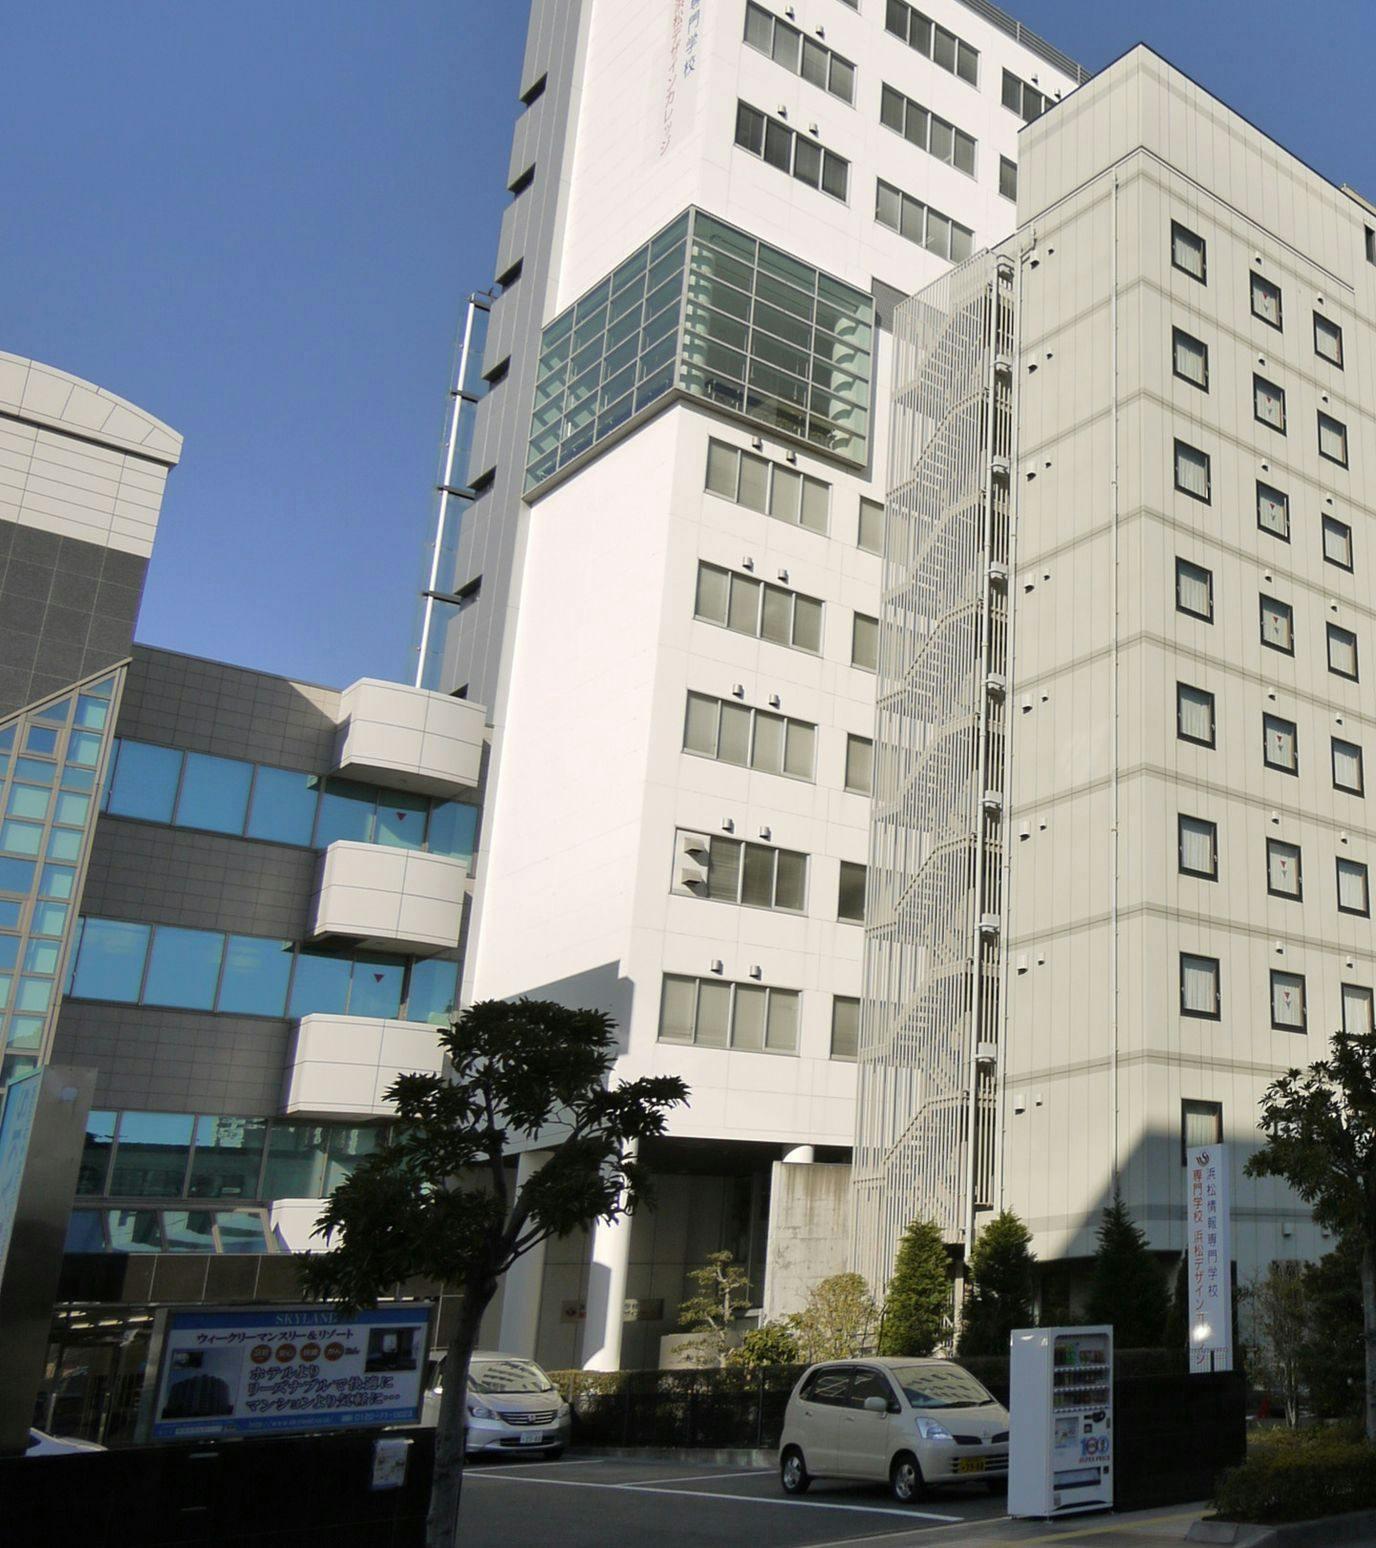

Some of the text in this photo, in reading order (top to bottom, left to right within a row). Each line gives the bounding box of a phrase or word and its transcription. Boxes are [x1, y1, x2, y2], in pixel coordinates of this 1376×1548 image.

[1193, 1169, 1204, 1223] 専門学校
[1207, 1166, 1218, 1298] 浜松情報専門学校
[250, 1364, 320, 1381] ホテルより
